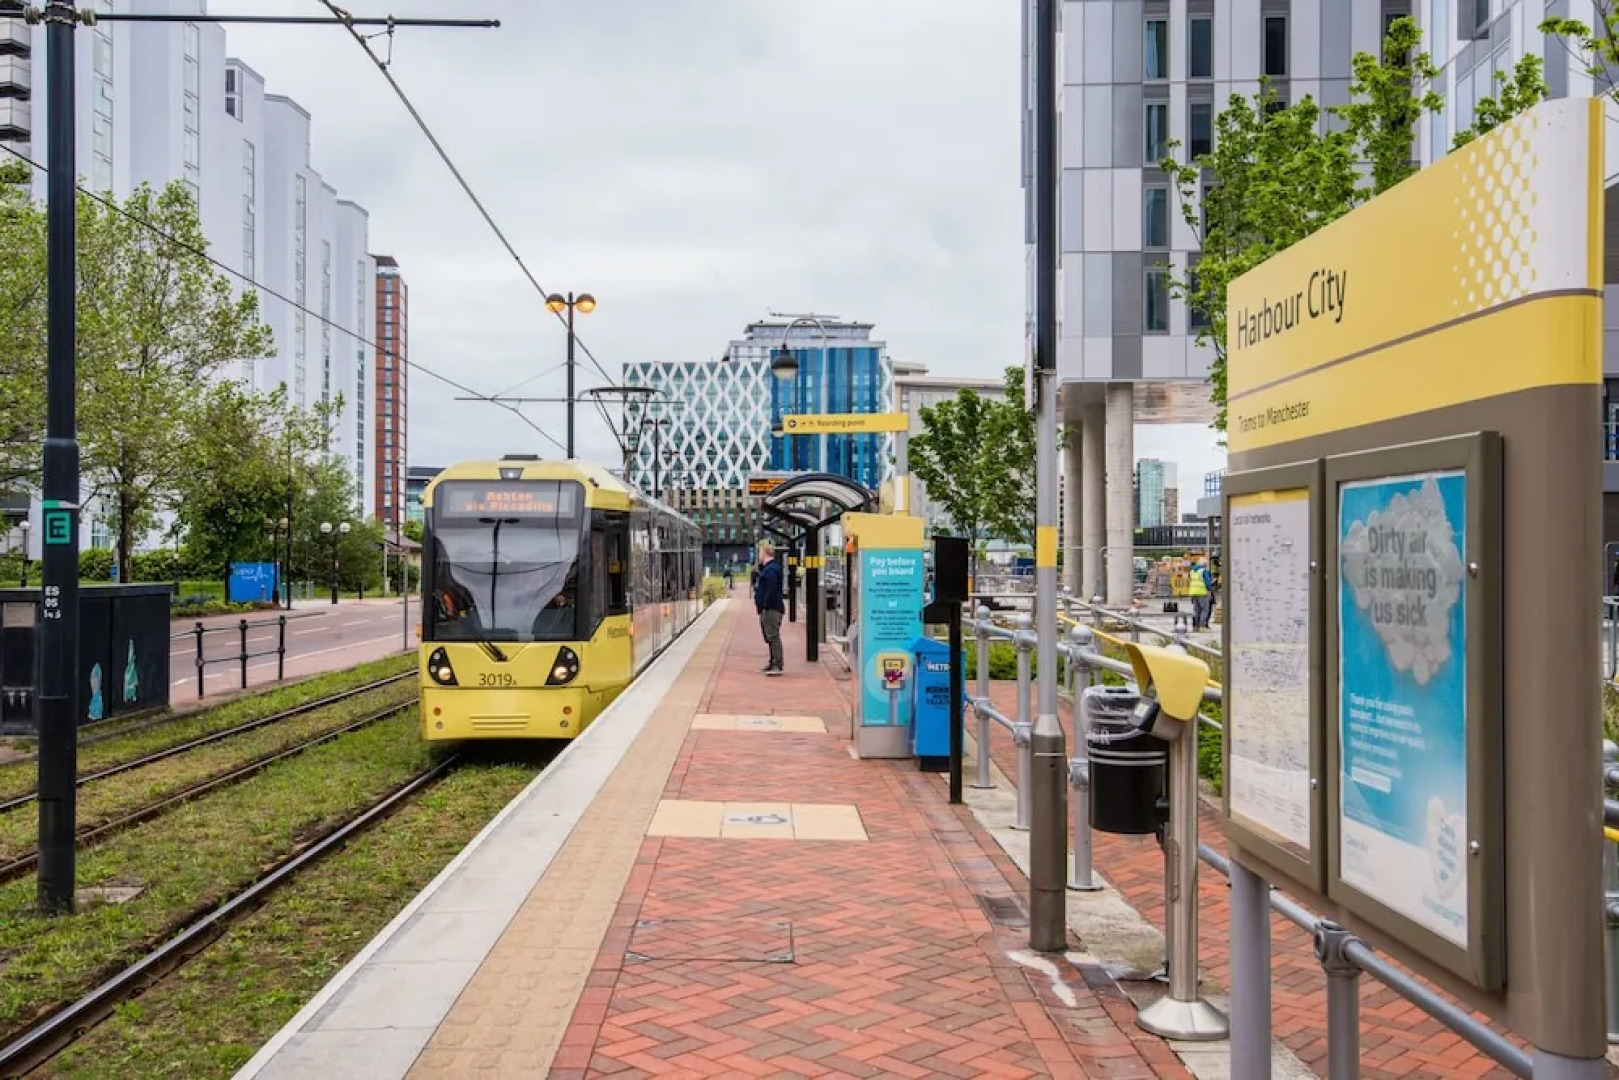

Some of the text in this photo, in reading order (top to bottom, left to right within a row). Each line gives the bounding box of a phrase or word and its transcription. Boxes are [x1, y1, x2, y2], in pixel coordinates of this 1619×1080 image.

[1237, 268, 1347, 350] Harbour City
[817, 420, 865, 428] Boarding point
[1238, 401, 1310, 433] Trams to Manchester
[464, 501, 553, 512] via Piccadilly
[486, 491, 532, 502] Ashton
[1368, 523, 1428, 557] Dirty air
[870, 556, 916, 568] Pay before
[871, 567, 914, 577] you board
[1364, 560, 1438, 598] is making
[1373, 597, 1427, 627] us sick
